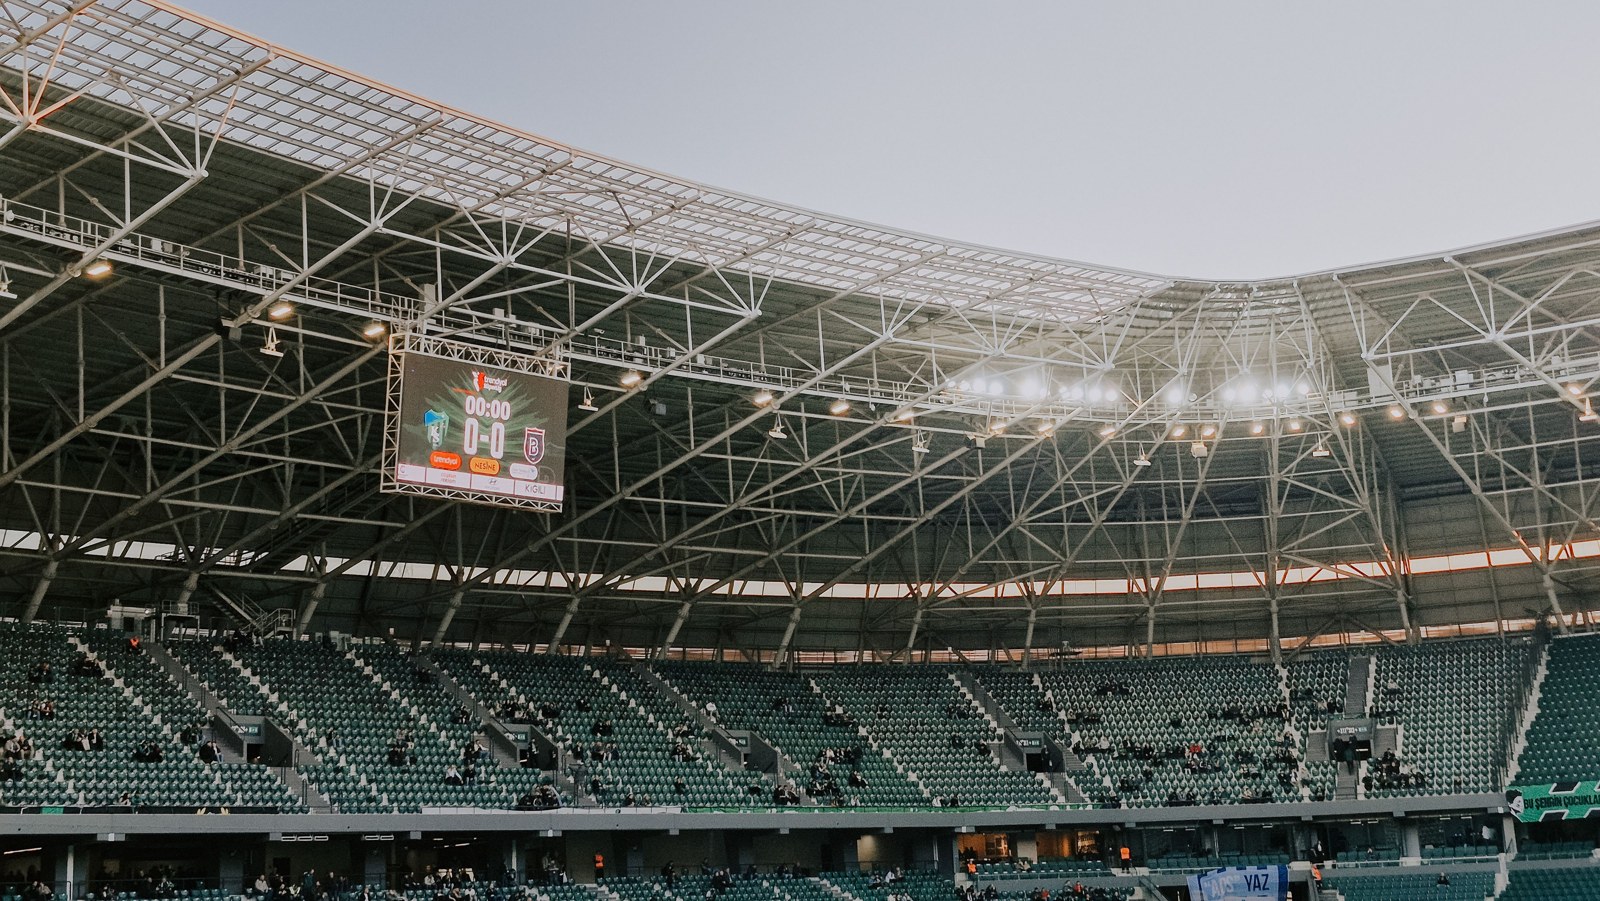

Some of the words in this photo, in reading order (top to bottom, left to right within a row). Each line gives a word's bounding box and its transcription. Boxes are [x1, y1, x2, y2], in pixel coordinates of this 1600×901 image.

[465, 395, 511, 421] 00:00
[464, 417, 505, 460] 0-0
[433, 455, 459, 466] trendyol
[1523, 798, 1534, 810] BU
[1243, 874, 1270, 892] YAZ
